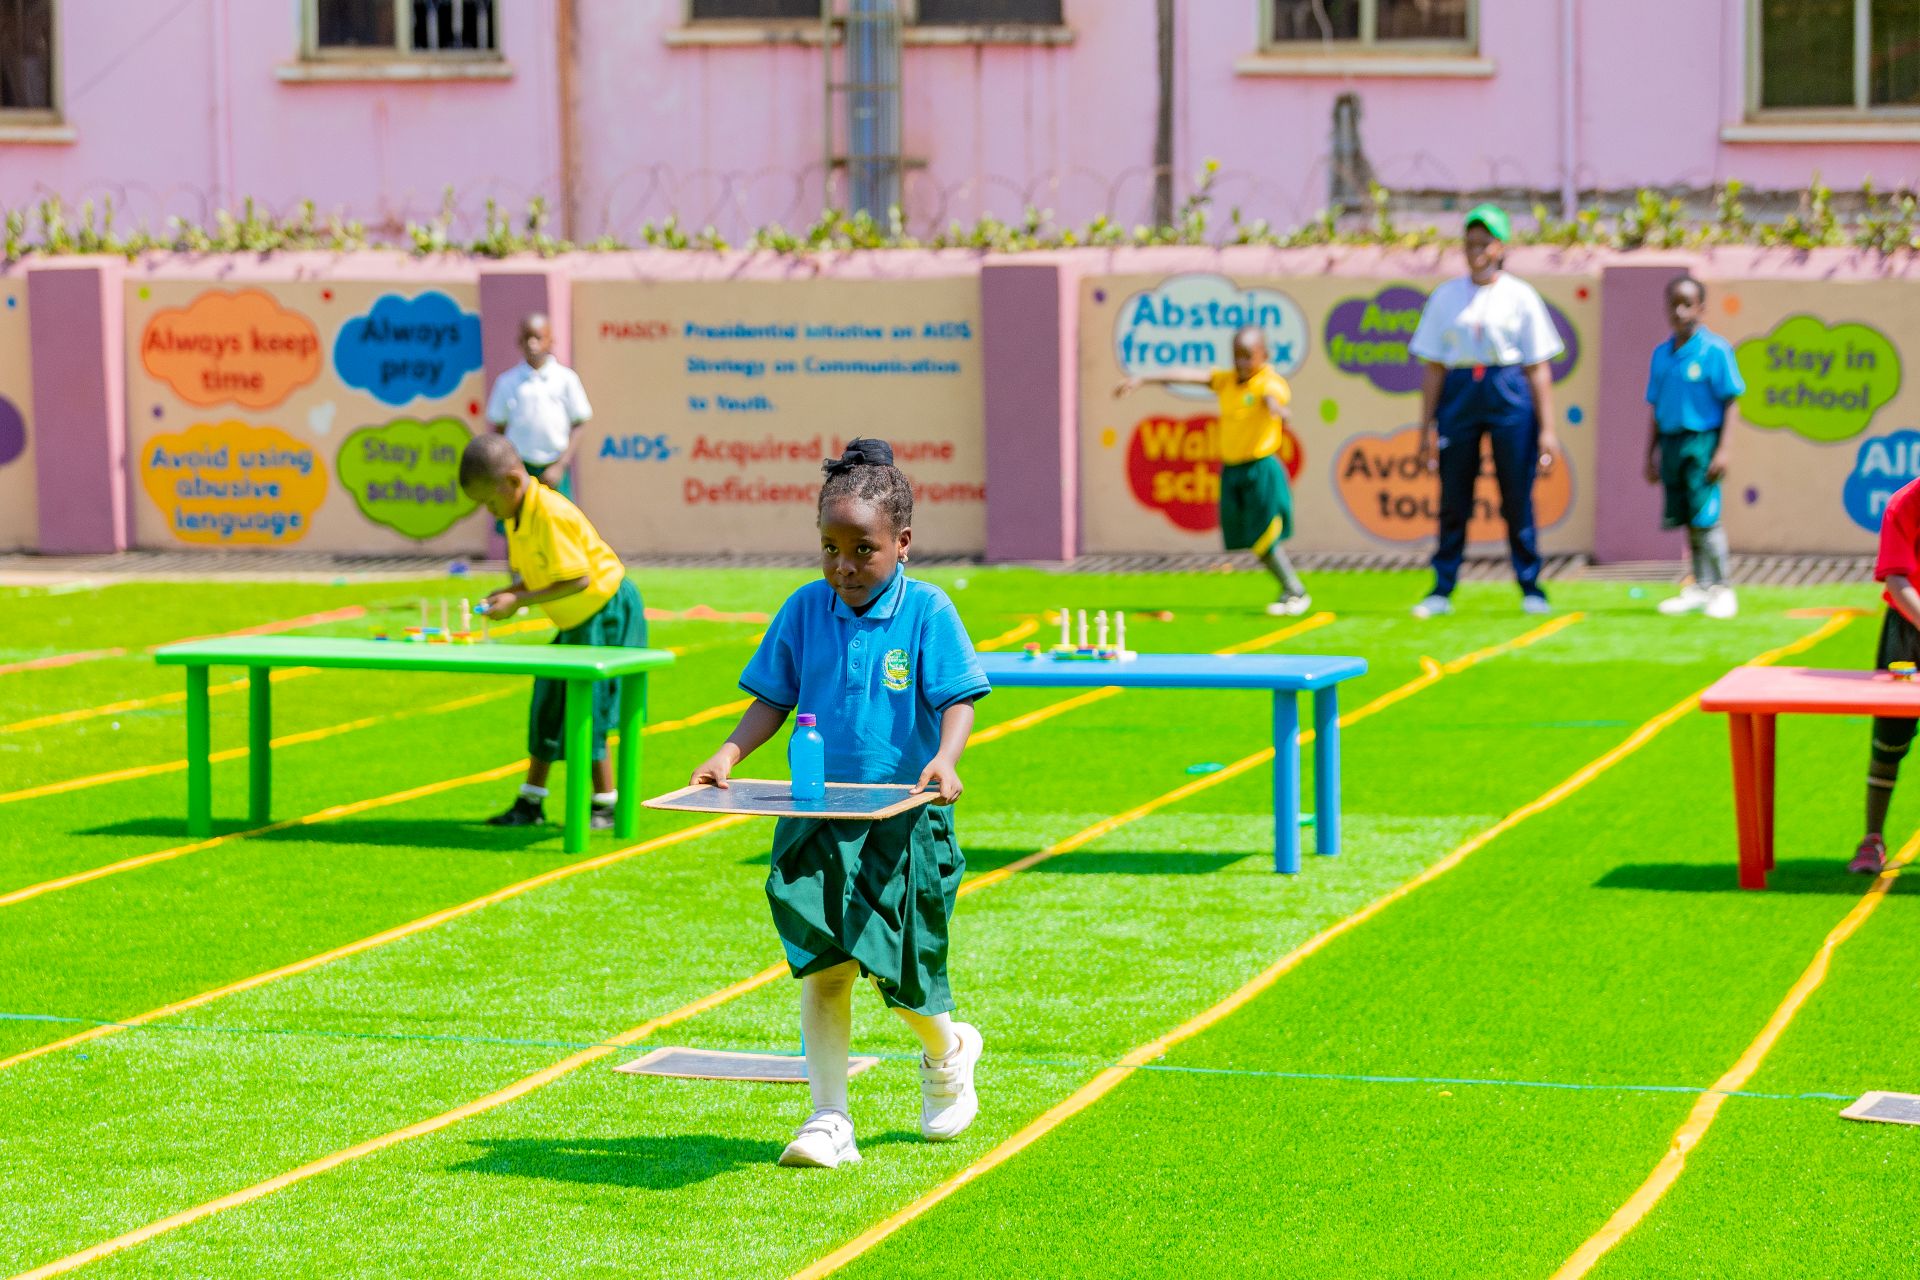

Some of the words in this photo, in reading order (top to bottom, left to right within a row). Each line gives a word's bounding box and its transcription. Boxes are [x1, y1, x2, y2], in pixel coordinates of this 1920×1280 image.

[1133, 293, 1282, 327] Abstain
[1361, 304, 1421, 331] Avo
[149, 328, 241, 358] Always
[250, 326, 317, 359] keep
[360, 317, 460, 350] Always
[685, 321, 797, 339] Presidential
[922, 322, 971, 339] AIDS
[1122, 333, 1215, 364] from
[1331, 336, 1409, 363] from
[1767, 346, 1834, 375] Stay
[1846, 343, 1875, 368] in
[202, 368, 264, 391] time
[381, 360, 443, 386] pray
[687, 357, 765, 376] Strategy
[803, 356, 960, 374] Communication
[1767, 385, 1869, 409] school
[152, 445, 229, 468] Avoid
[239, 446, 313, 474] using
[363, 439, 419, 470] Stay
[430, 438, 456, 463] in
[691, 434, 822, 468] Acquired
[177, 474, 279, 498] abusive
[367, 479, 457, 503] school
